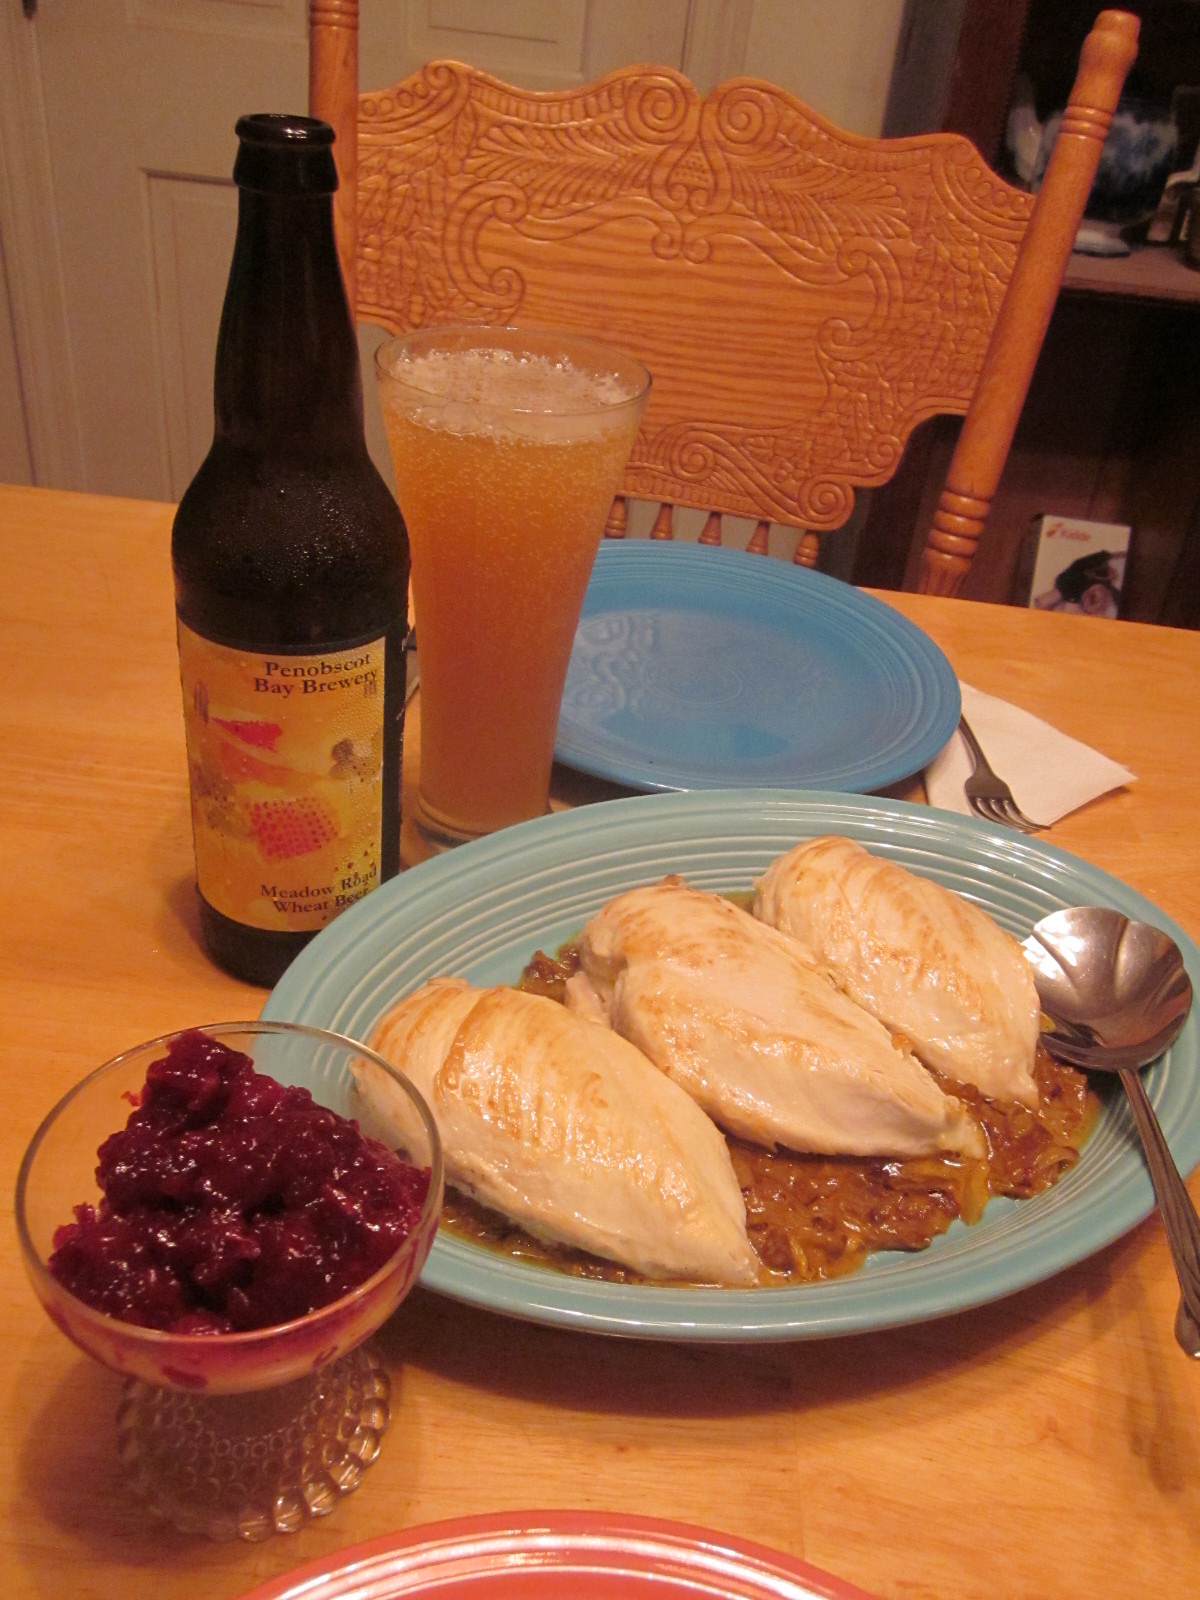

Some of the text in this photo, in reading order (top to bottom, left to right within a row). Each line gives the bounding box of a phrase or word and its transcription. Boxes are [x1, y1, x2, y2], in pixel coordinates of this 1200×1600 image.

[265, 654, 370, 677] Penobscot
[253, 669, 377, 698] Bay Brewery
[261, 867, 377, 898] Meadow Road
[273, 888, 369, 913] Wheat Beer
